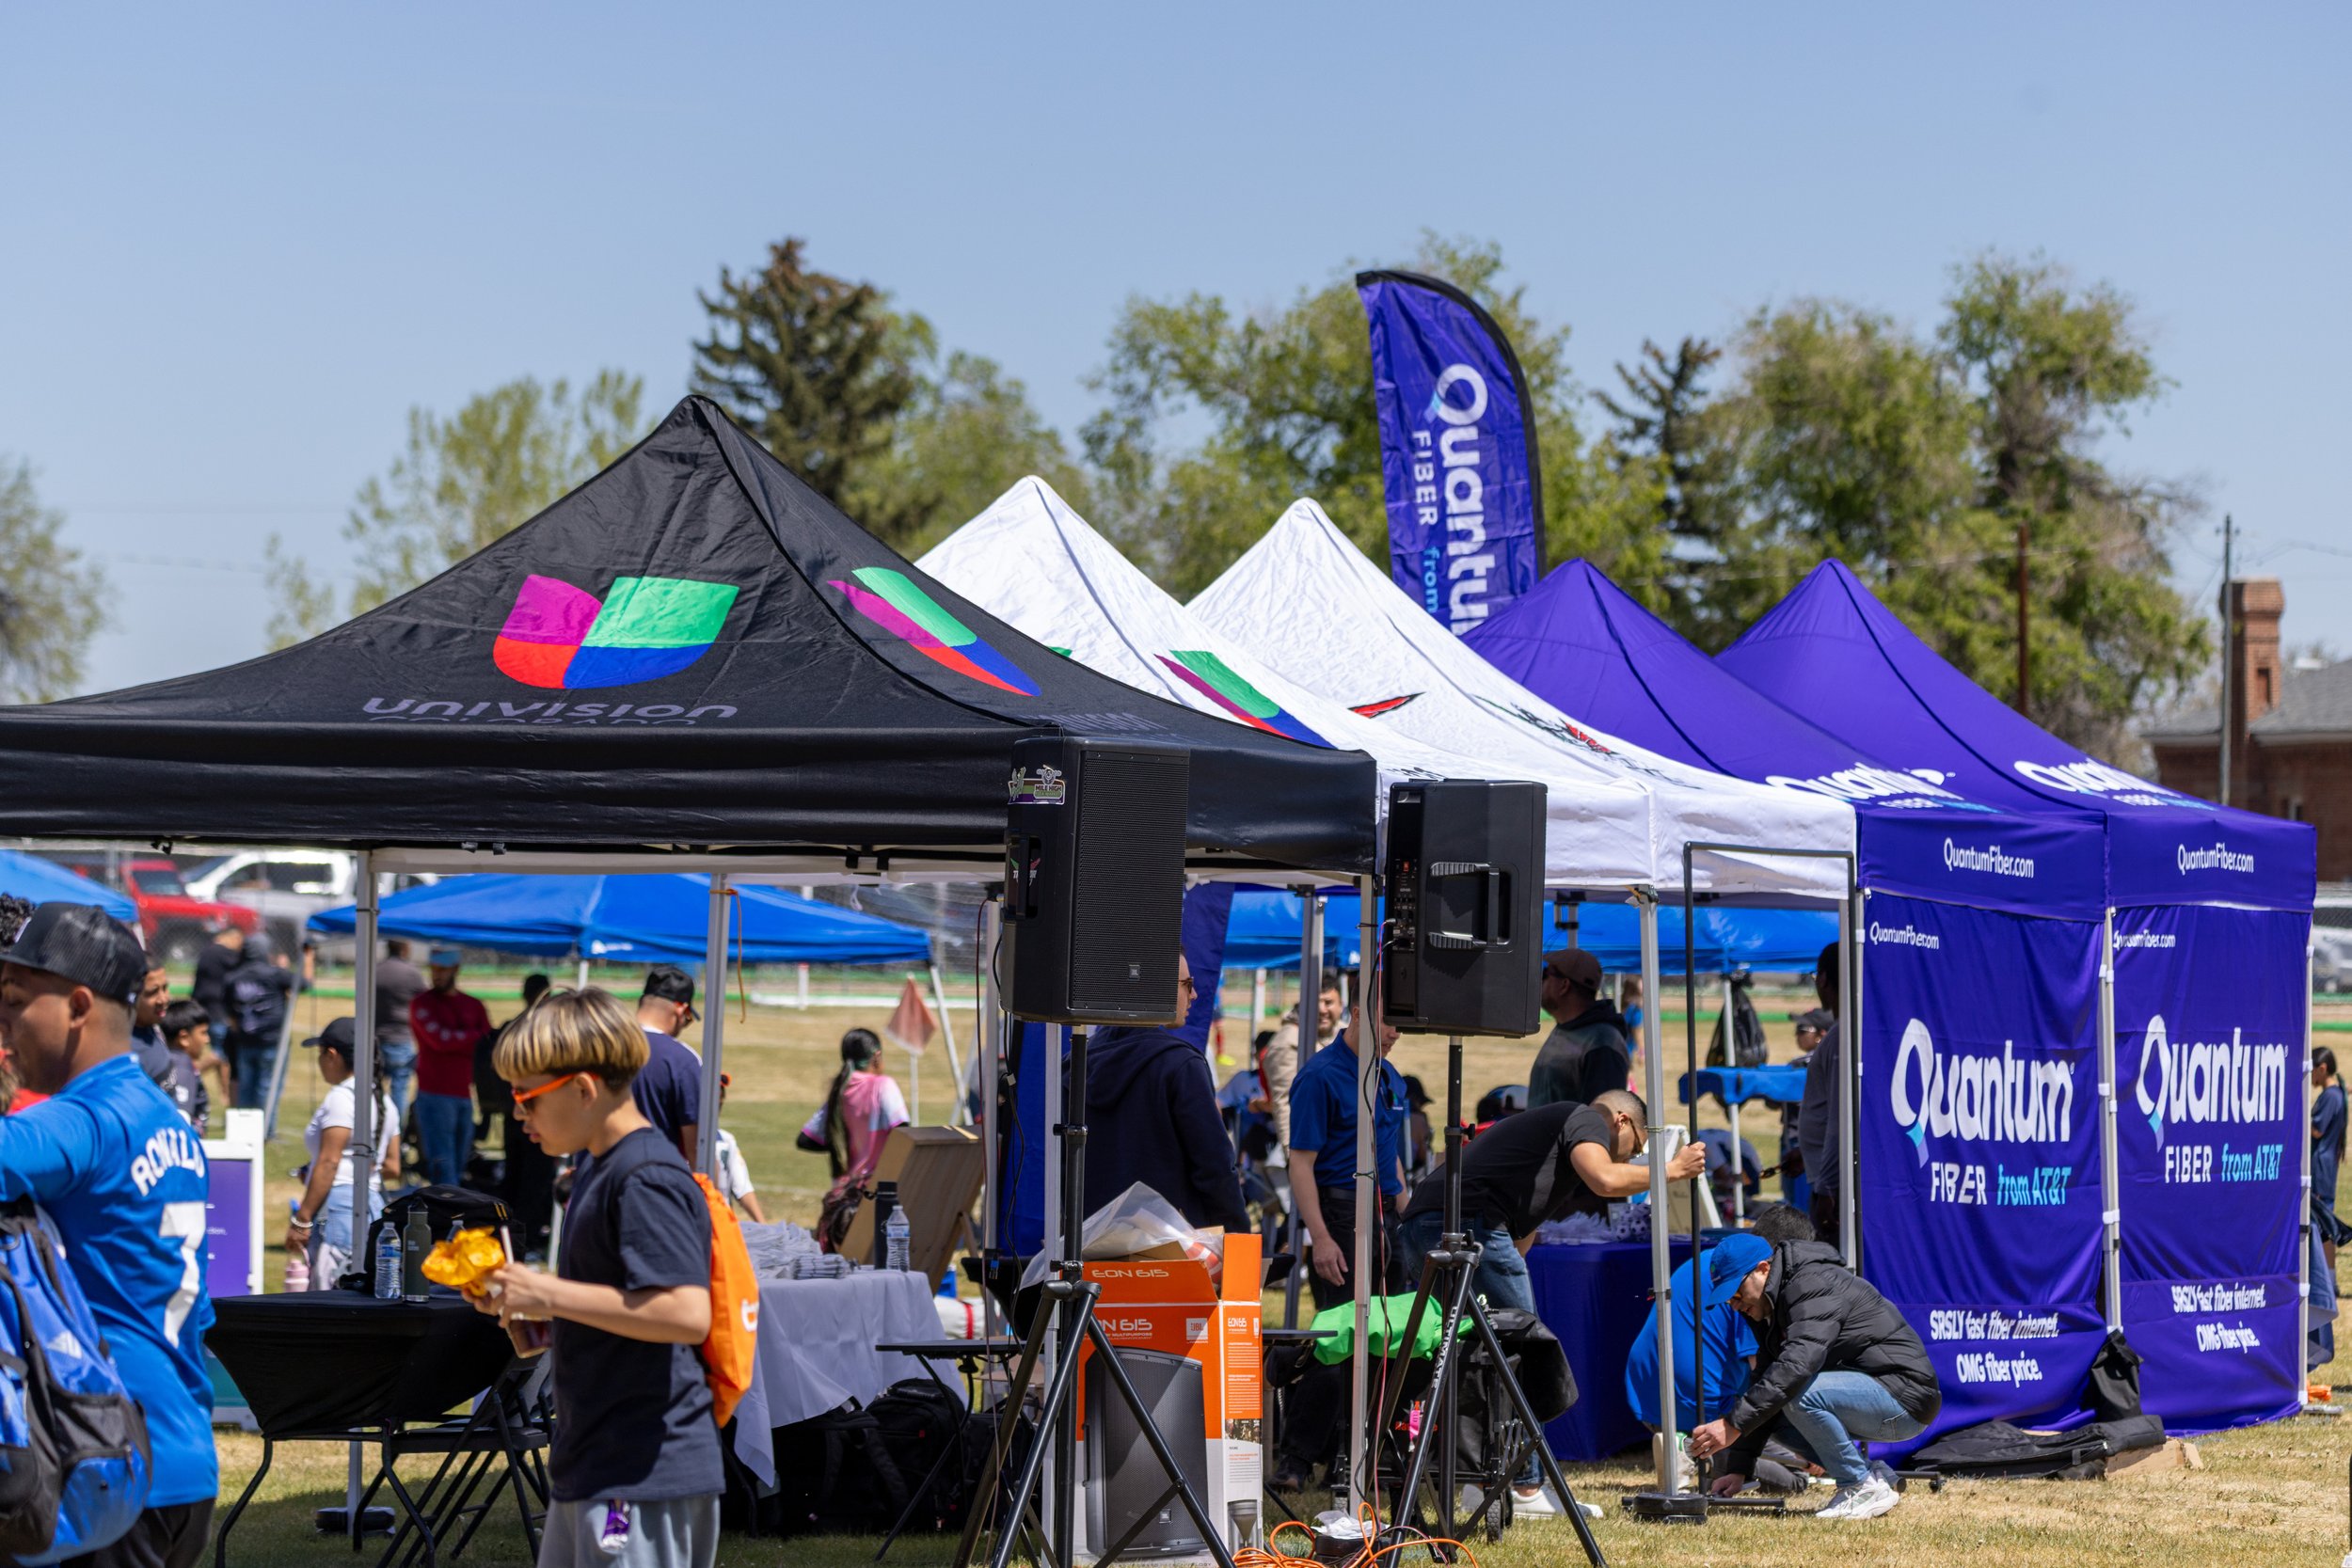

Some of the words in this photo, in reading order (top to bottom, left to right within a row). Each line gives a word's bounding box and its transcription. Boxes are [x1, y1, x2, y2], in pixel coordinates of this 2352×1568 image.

[1412, 430, 1438, 526] FIBER
[1423, 546, 1440, 614] from
[1944, 837, 2034, 879] QuantumFiber.com
[2177, 844, 2254, 876] QuantumFiber.com
[1891, 1018, 2074, 1168] Quantum
[2136, 1014, 2286, 1154] Quantum
[2165, 1145, 2213, 1183] FIBER
[2221, 1143, 2252, 1182] from
[2253, 1144, 2283, 1181] AT&T
[1931, 1162, 1988, 1206] FIBER
[1996, 1164, 2031, 1206] from
[2032, 1166, 2072, 1205] AT&T
[159, 1201, 206, 1349] 7
[1091, 1269, 1133, 1278] EON
[1136, 1269, 1169, 1278] 615
[2171, 1285, 2197, 1313] SRSLY
[2197, 1285, 2214, 1312] fast
[2214, 1283, 2234, 1312] fiber
[2234, 1282, 2266, 1310] internet.
[1120, 1319, 1153, 1331] 615
[1930, 1309, 1965, 1340] SRSLY
[1965, 1310, 1988, 1339] fast
[1987, 1309, 2016, 1339] fiber
[2012, 1309, 2060, 1339] internet.
[2196, 1323, 2221, 1353] OMG
[1431, 1306, 1458, 1389] ULTIMATE
[1956, 1353, 1986, 1384] OMG
[1984, 1351, 2011, 1382] fiber
[2010, 1350, 2042, 1388] price.
